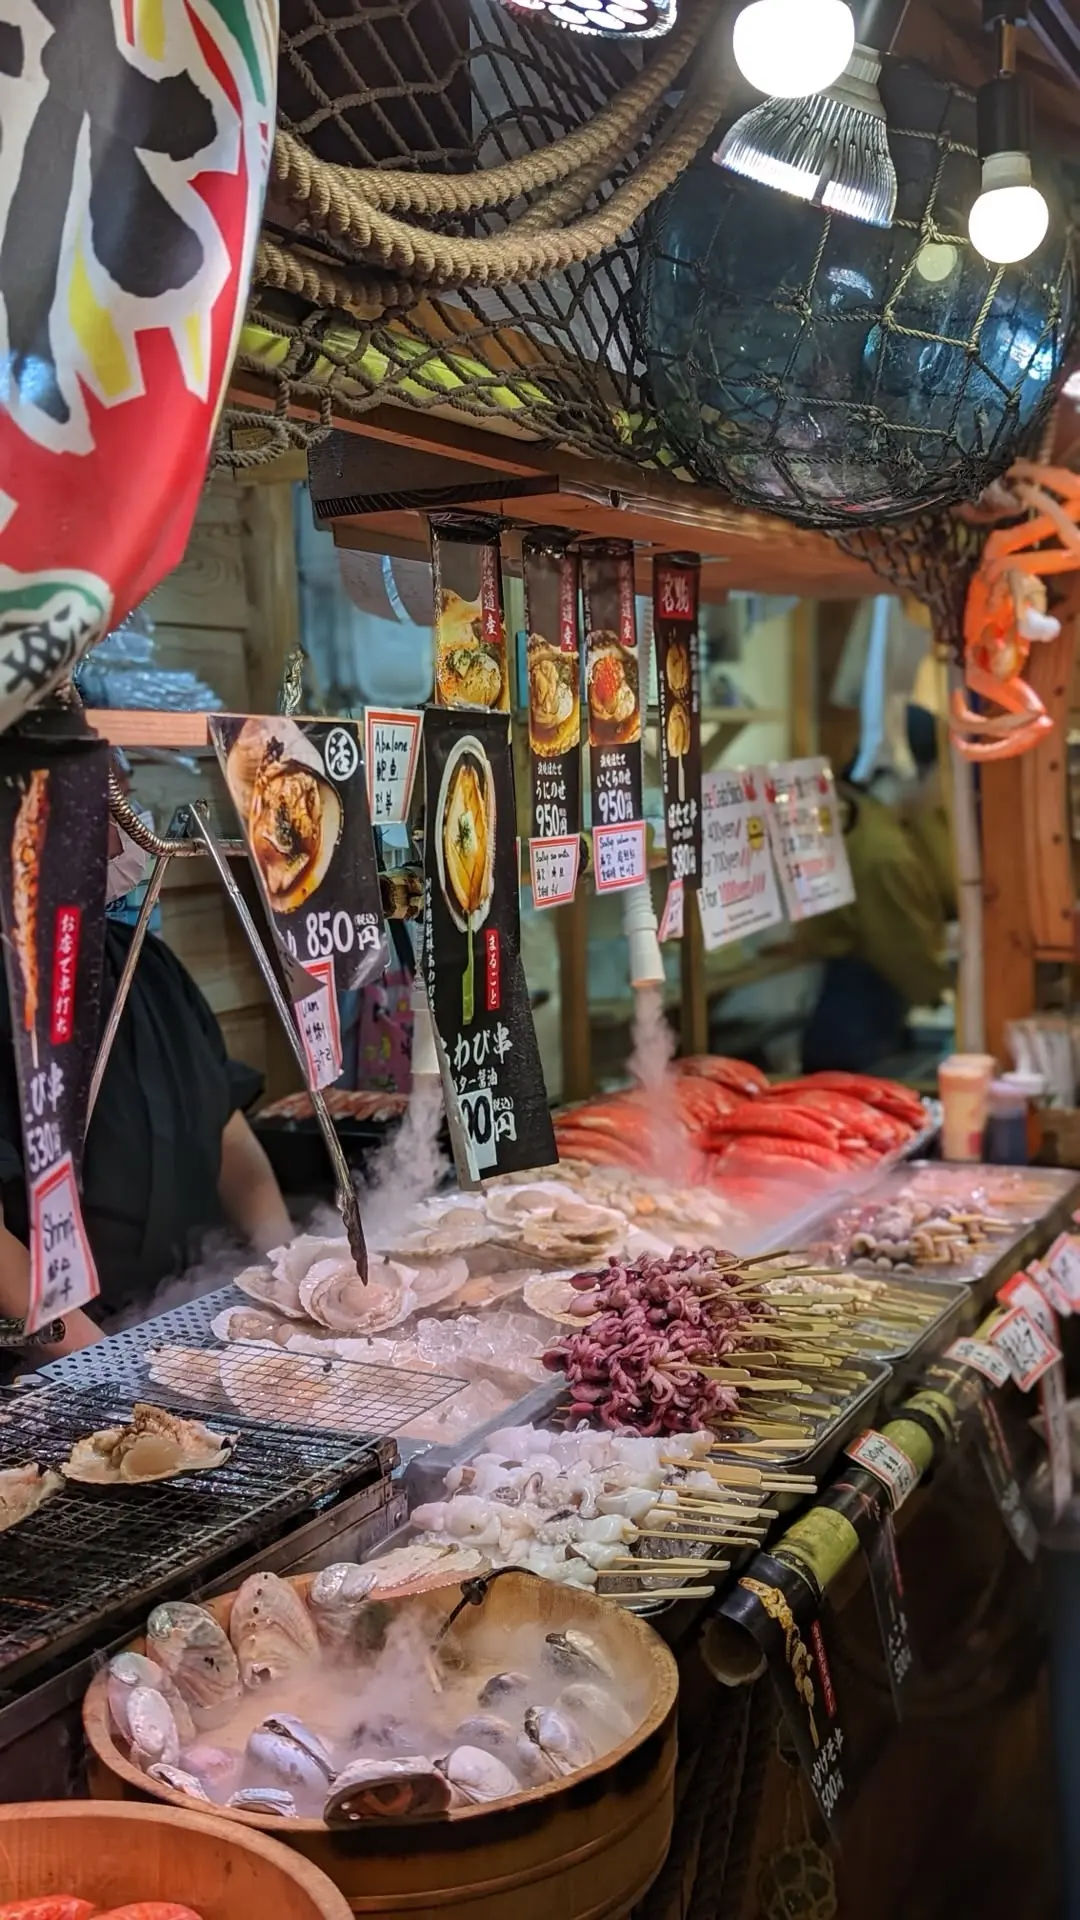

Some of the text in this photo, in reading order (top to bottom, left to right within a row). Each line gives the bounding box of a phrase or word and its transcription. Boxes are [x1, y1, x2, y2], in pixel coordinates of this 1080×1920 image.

[536, 780, 566, 800] うにのせ
[597, 768, 631, 788] いくらのせ
[489, 934, 498, 1005] まるごと
[25, 1062, 64, 1122] び串
